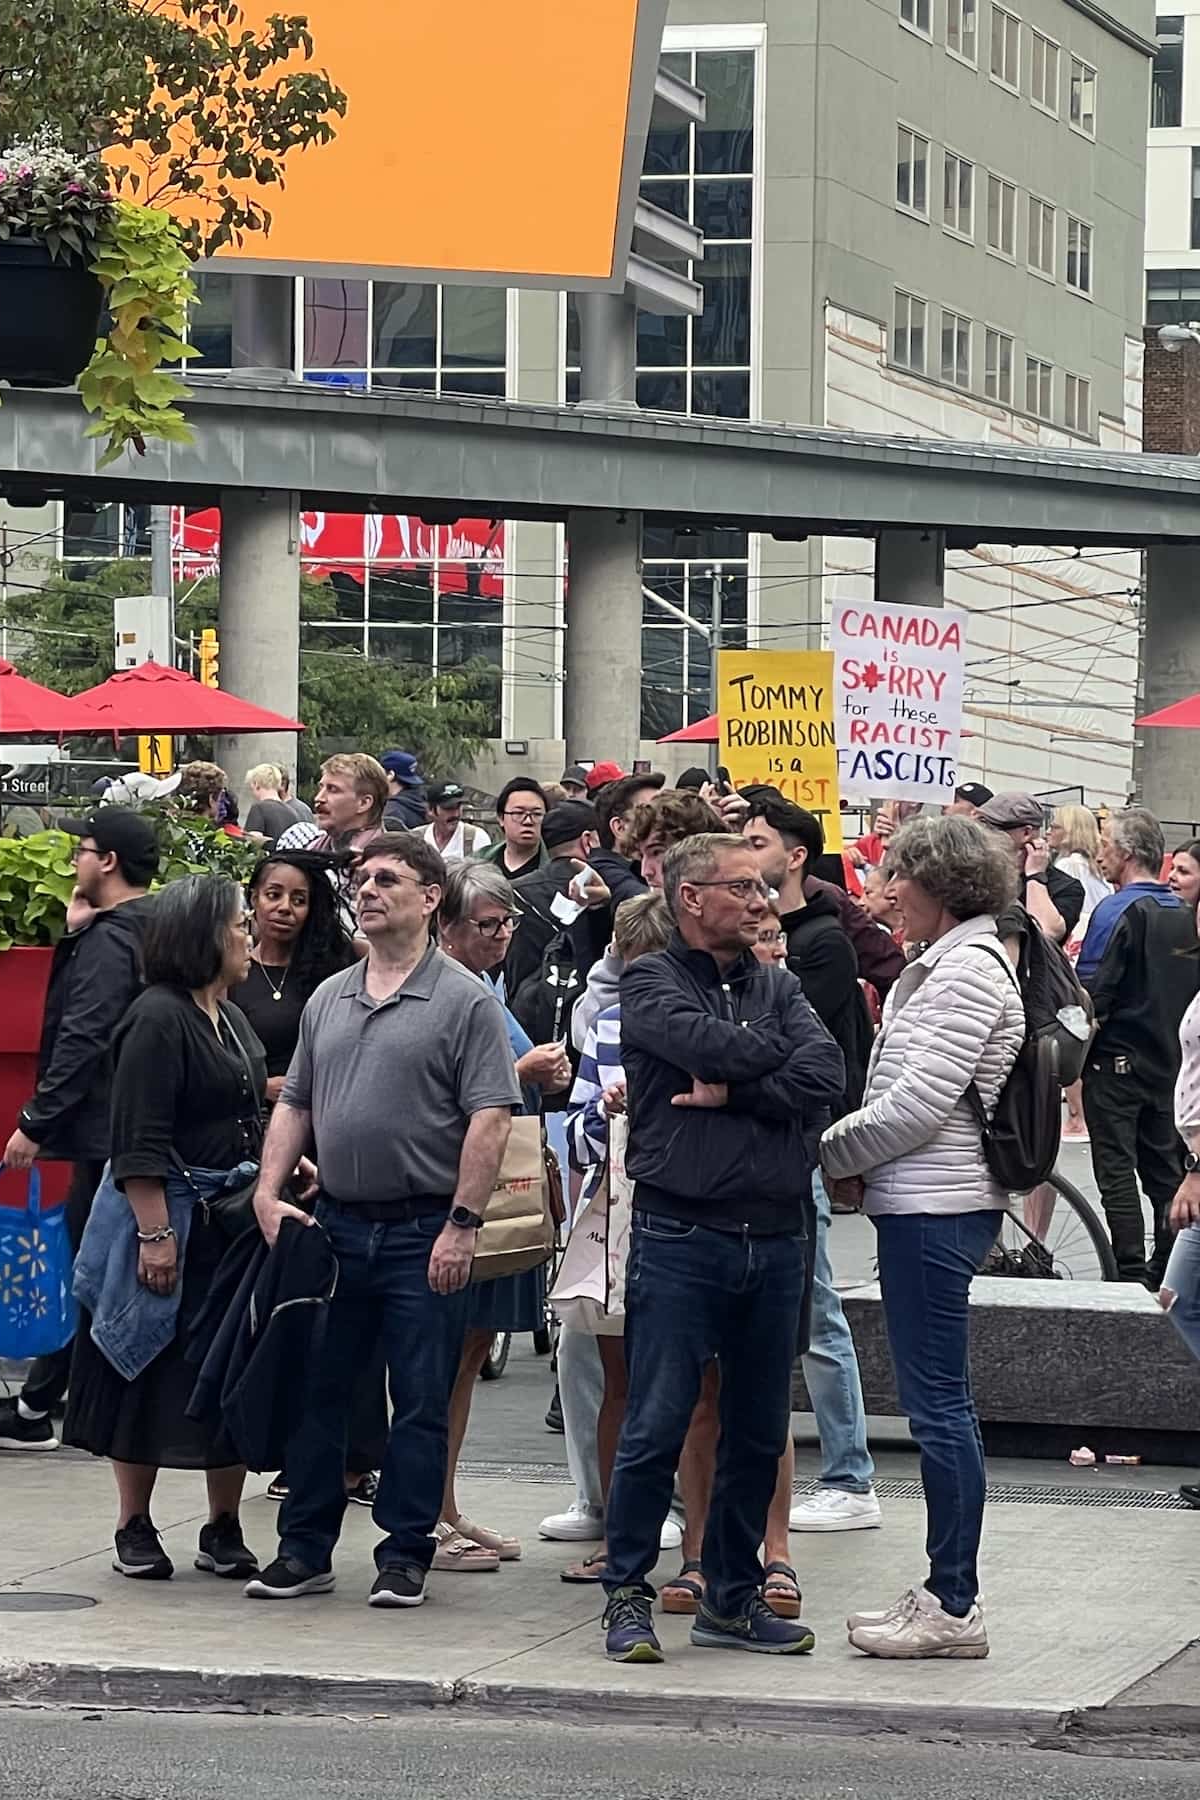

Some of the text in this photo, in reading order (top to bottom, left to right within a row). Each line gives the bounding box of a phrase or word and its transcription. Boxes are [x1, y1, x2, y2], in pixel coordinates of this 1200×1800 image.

[840, 609, 960, 653] CANADA
[883, 647, 899, 663] is
[728, 674, 824, 713] TOMMY
[842, 659, 947, 702] SRRY
[842, 694, 939, 725] for these
[727, 717, 837, 748] ROBINSON
[850, 719, 952, 751] RACIST
[768, 756, 804, 774] is a
[11, 779, 50, 793] Street
